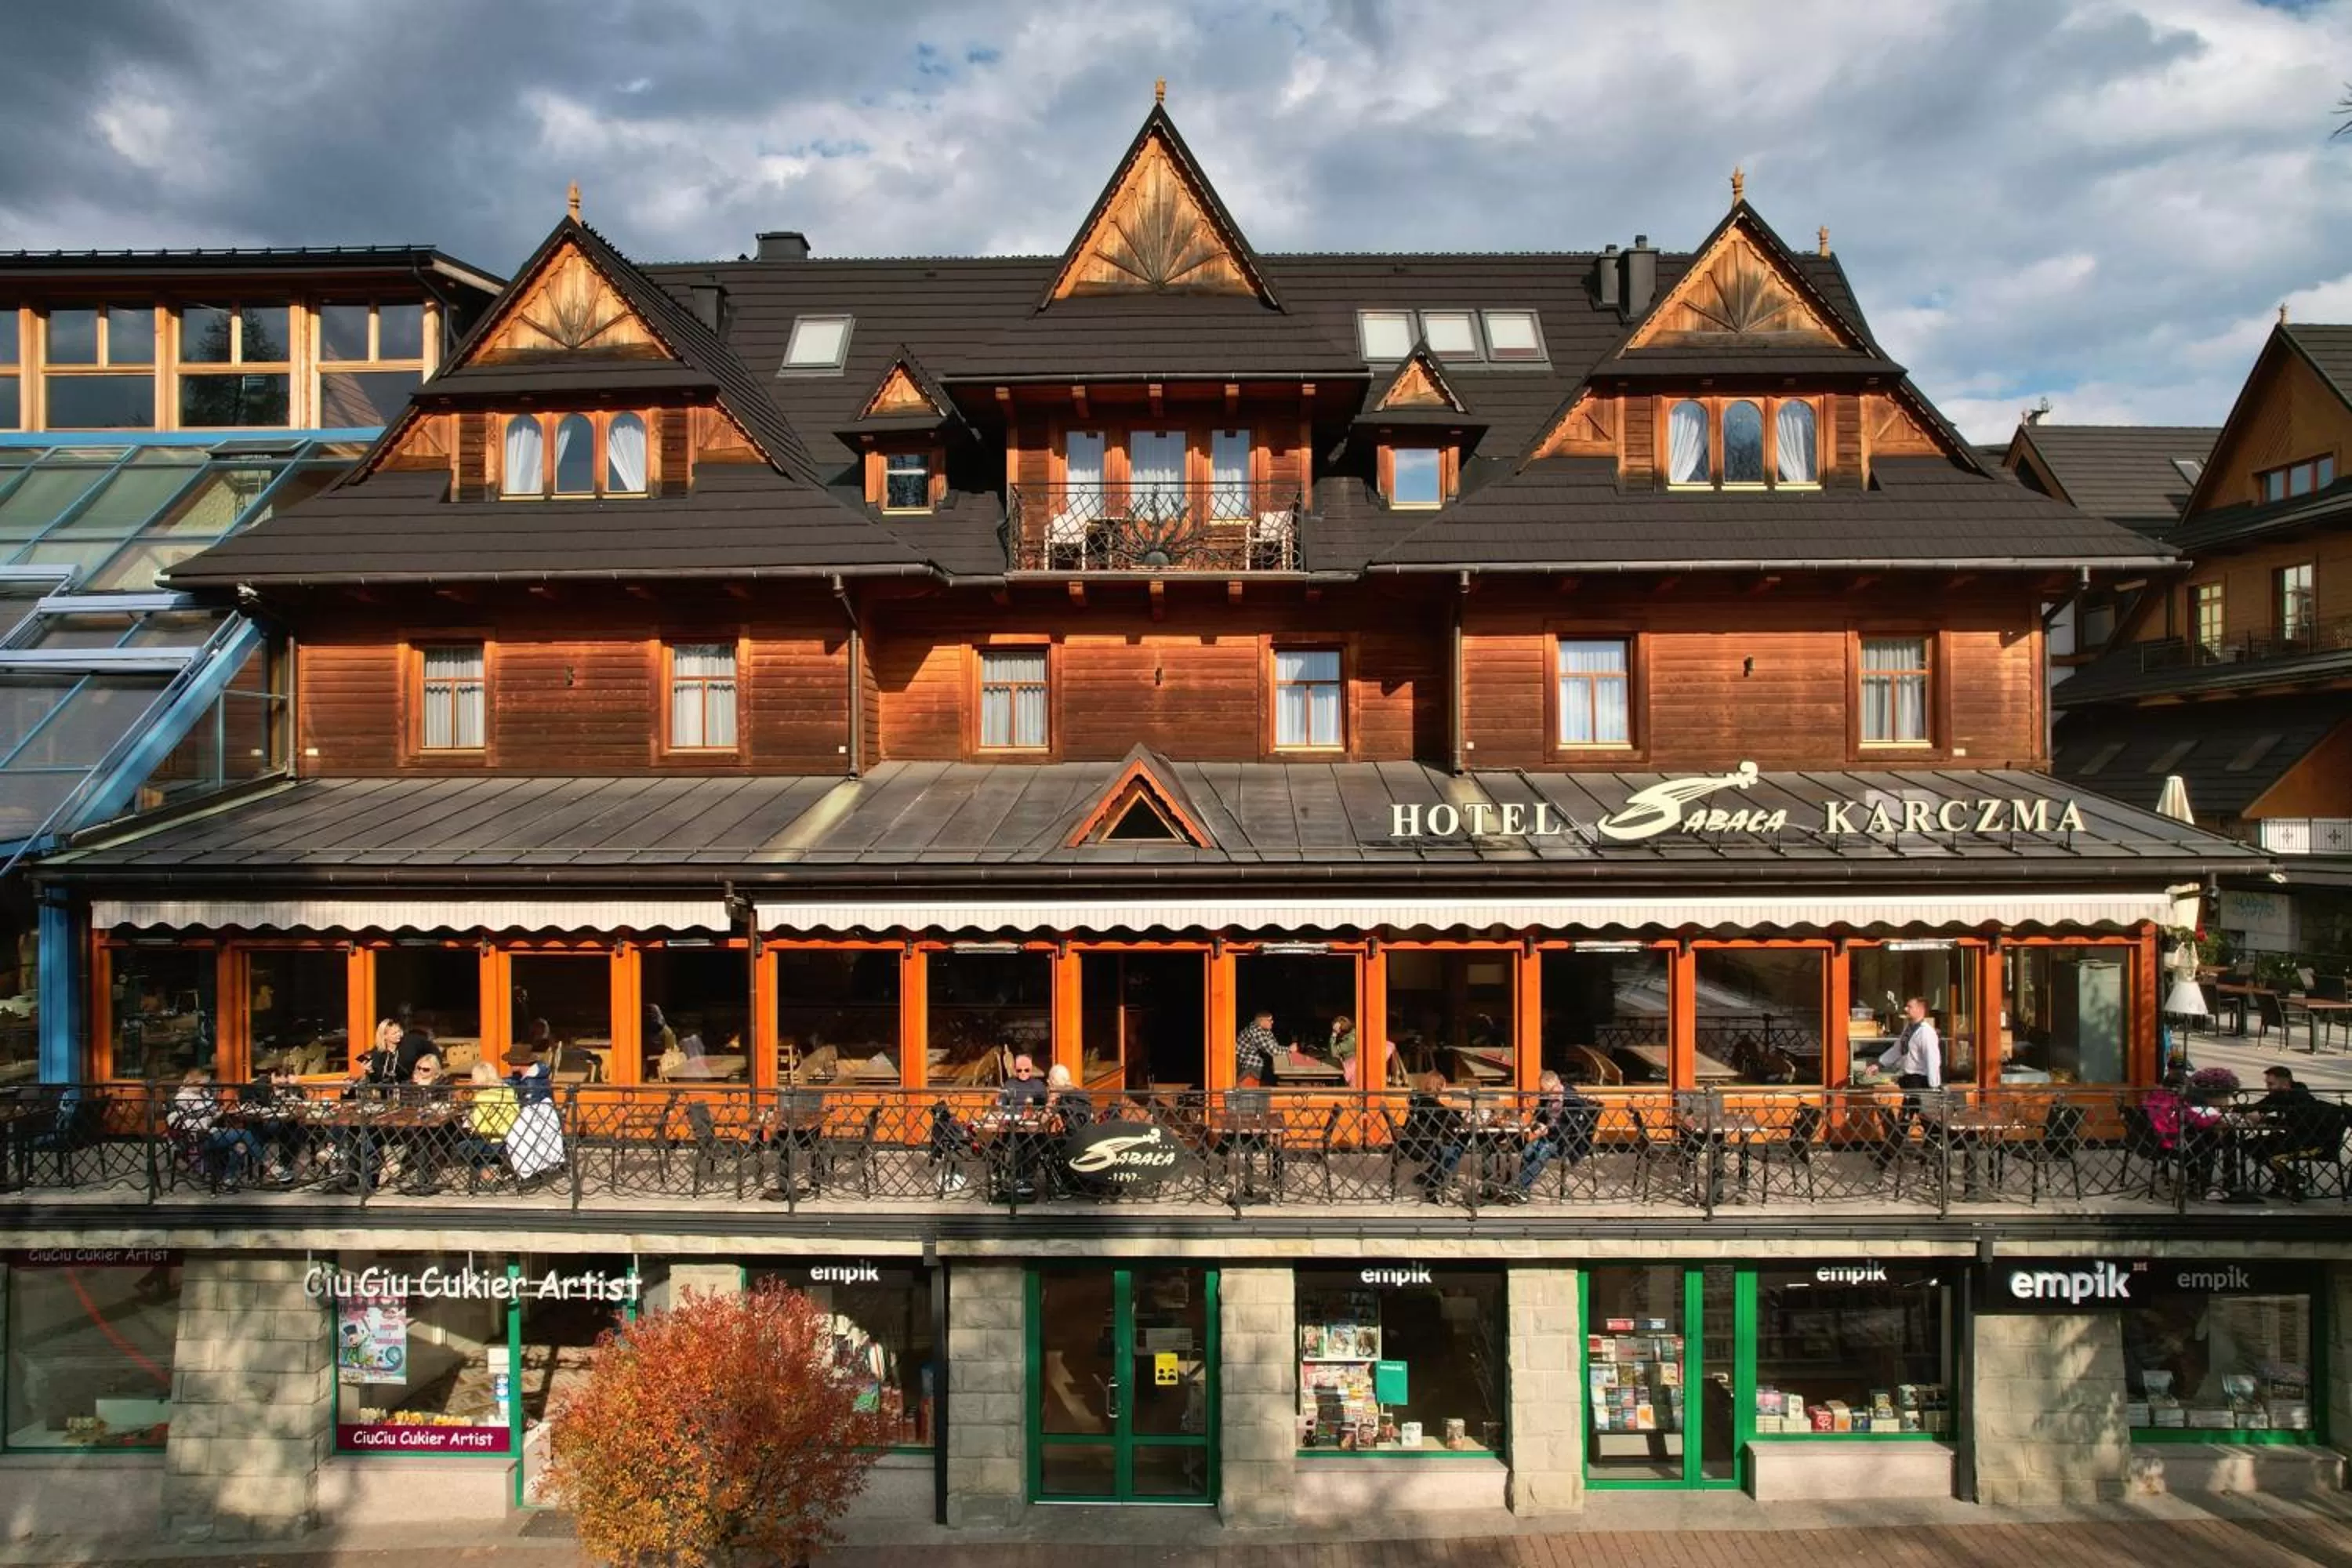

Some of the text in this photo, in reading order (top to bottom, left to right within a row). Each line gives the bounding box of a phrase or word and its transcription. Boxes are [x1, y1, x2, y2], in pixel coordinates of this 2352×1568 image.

[1389, 802, 1561, 837] HOTEL
[1824, 798, 2087, 833] KARCZMA
[28, 1248, 169, 1262] CiuCiu Cukier Artist
[420, 1266, 527, 1299] Cukier
[537, 1269, 643, 1301] Artist
[810, 1258, 880, 1285] empik
[1361, 1260, 1432, 1287] empik
[1817, 1258, 1887, 1285] empik
[2011, 1260, 2131, 1305] empik
[2177, 1265, 2250, 1291] empik
[354, 1431, 494, 1446] CiuCiu Cukier Artist
